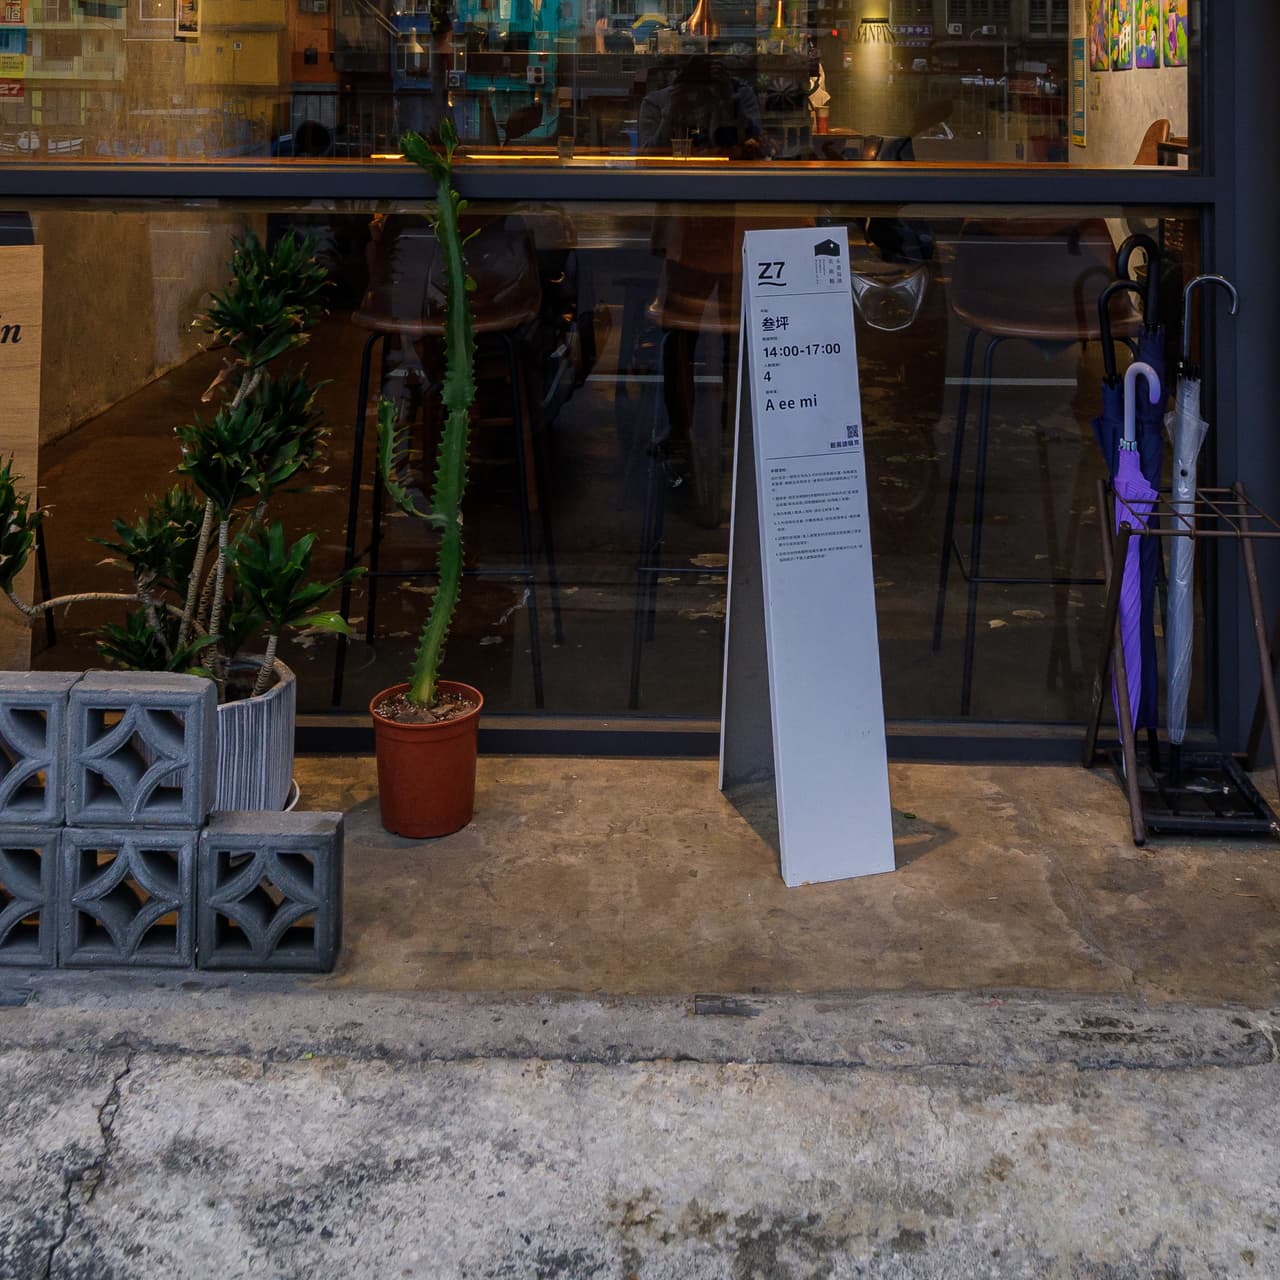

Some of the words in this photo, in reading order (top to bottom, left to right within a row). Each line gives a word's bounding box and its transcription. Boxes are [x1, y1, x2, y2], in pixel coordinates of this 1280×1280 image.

[757, 261, 786, 280] Z7
[761, 316, 790, 332] 叁坪
[763, 343, 841, 358] 14:00-17:00
[763, 371, 772, 382] 4
[765, 399, 775, 411] A
[779, 399, 796, 410] ee
[800, 394, 818, 409] mi
